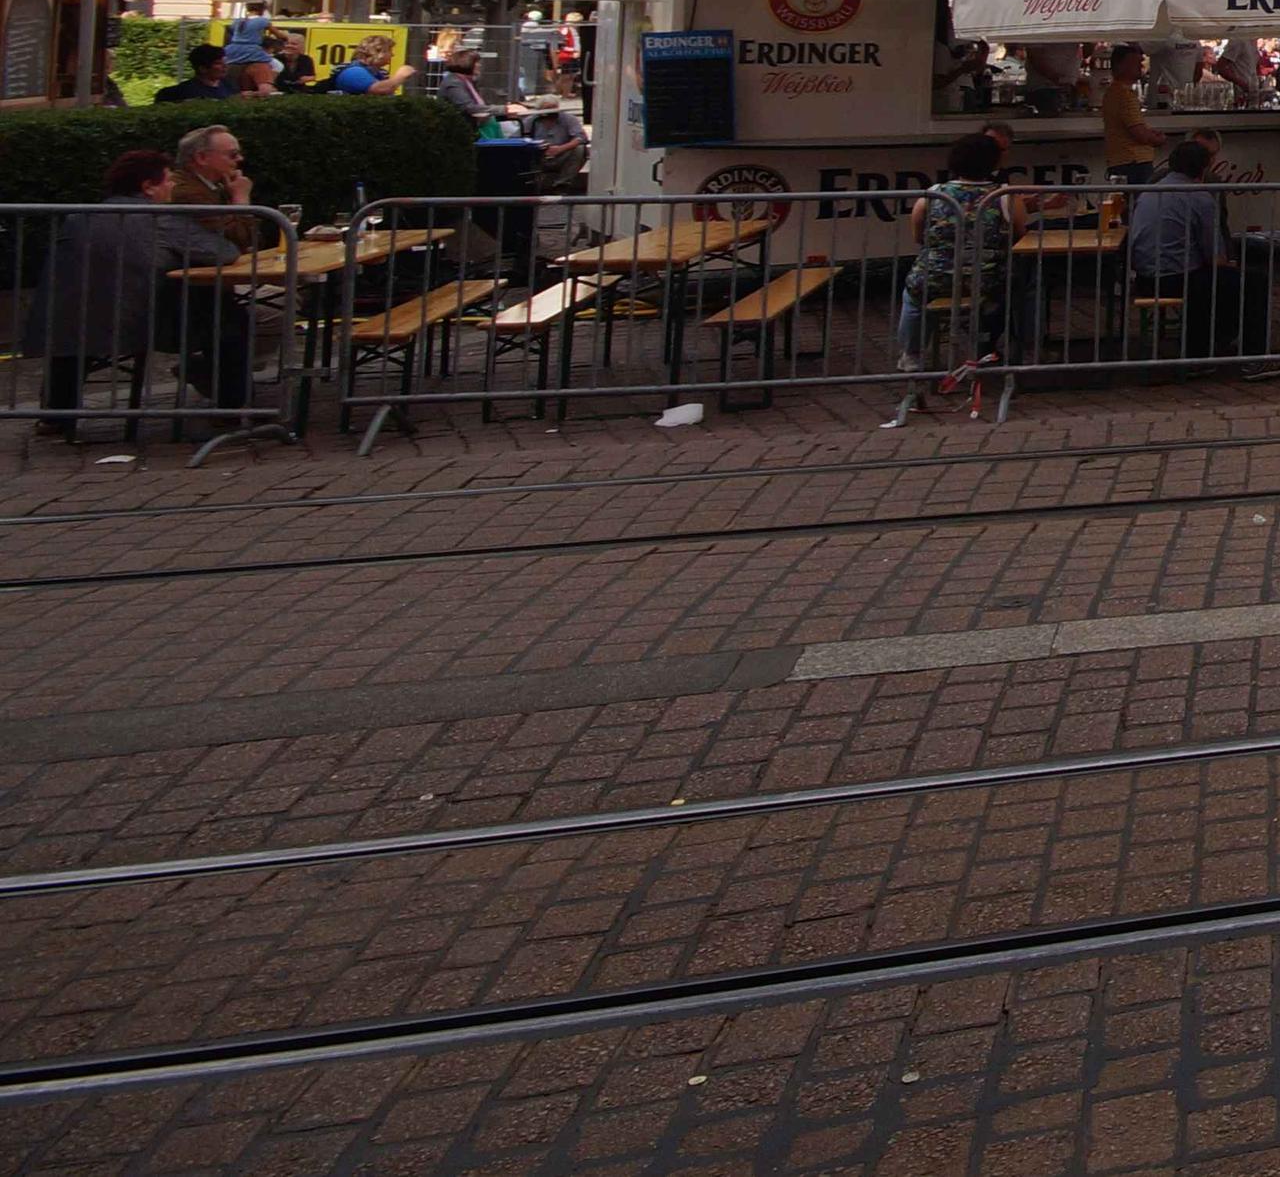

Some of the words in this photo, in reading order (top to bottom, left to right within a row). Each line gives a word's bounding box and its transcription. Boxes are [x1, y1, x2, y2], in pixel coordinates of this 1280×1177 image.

[645, 36, 714, 49] ERDINGER
[739, 40, 881, 66] ERDINGER
[761, 72, 854, 100] Weißbier
